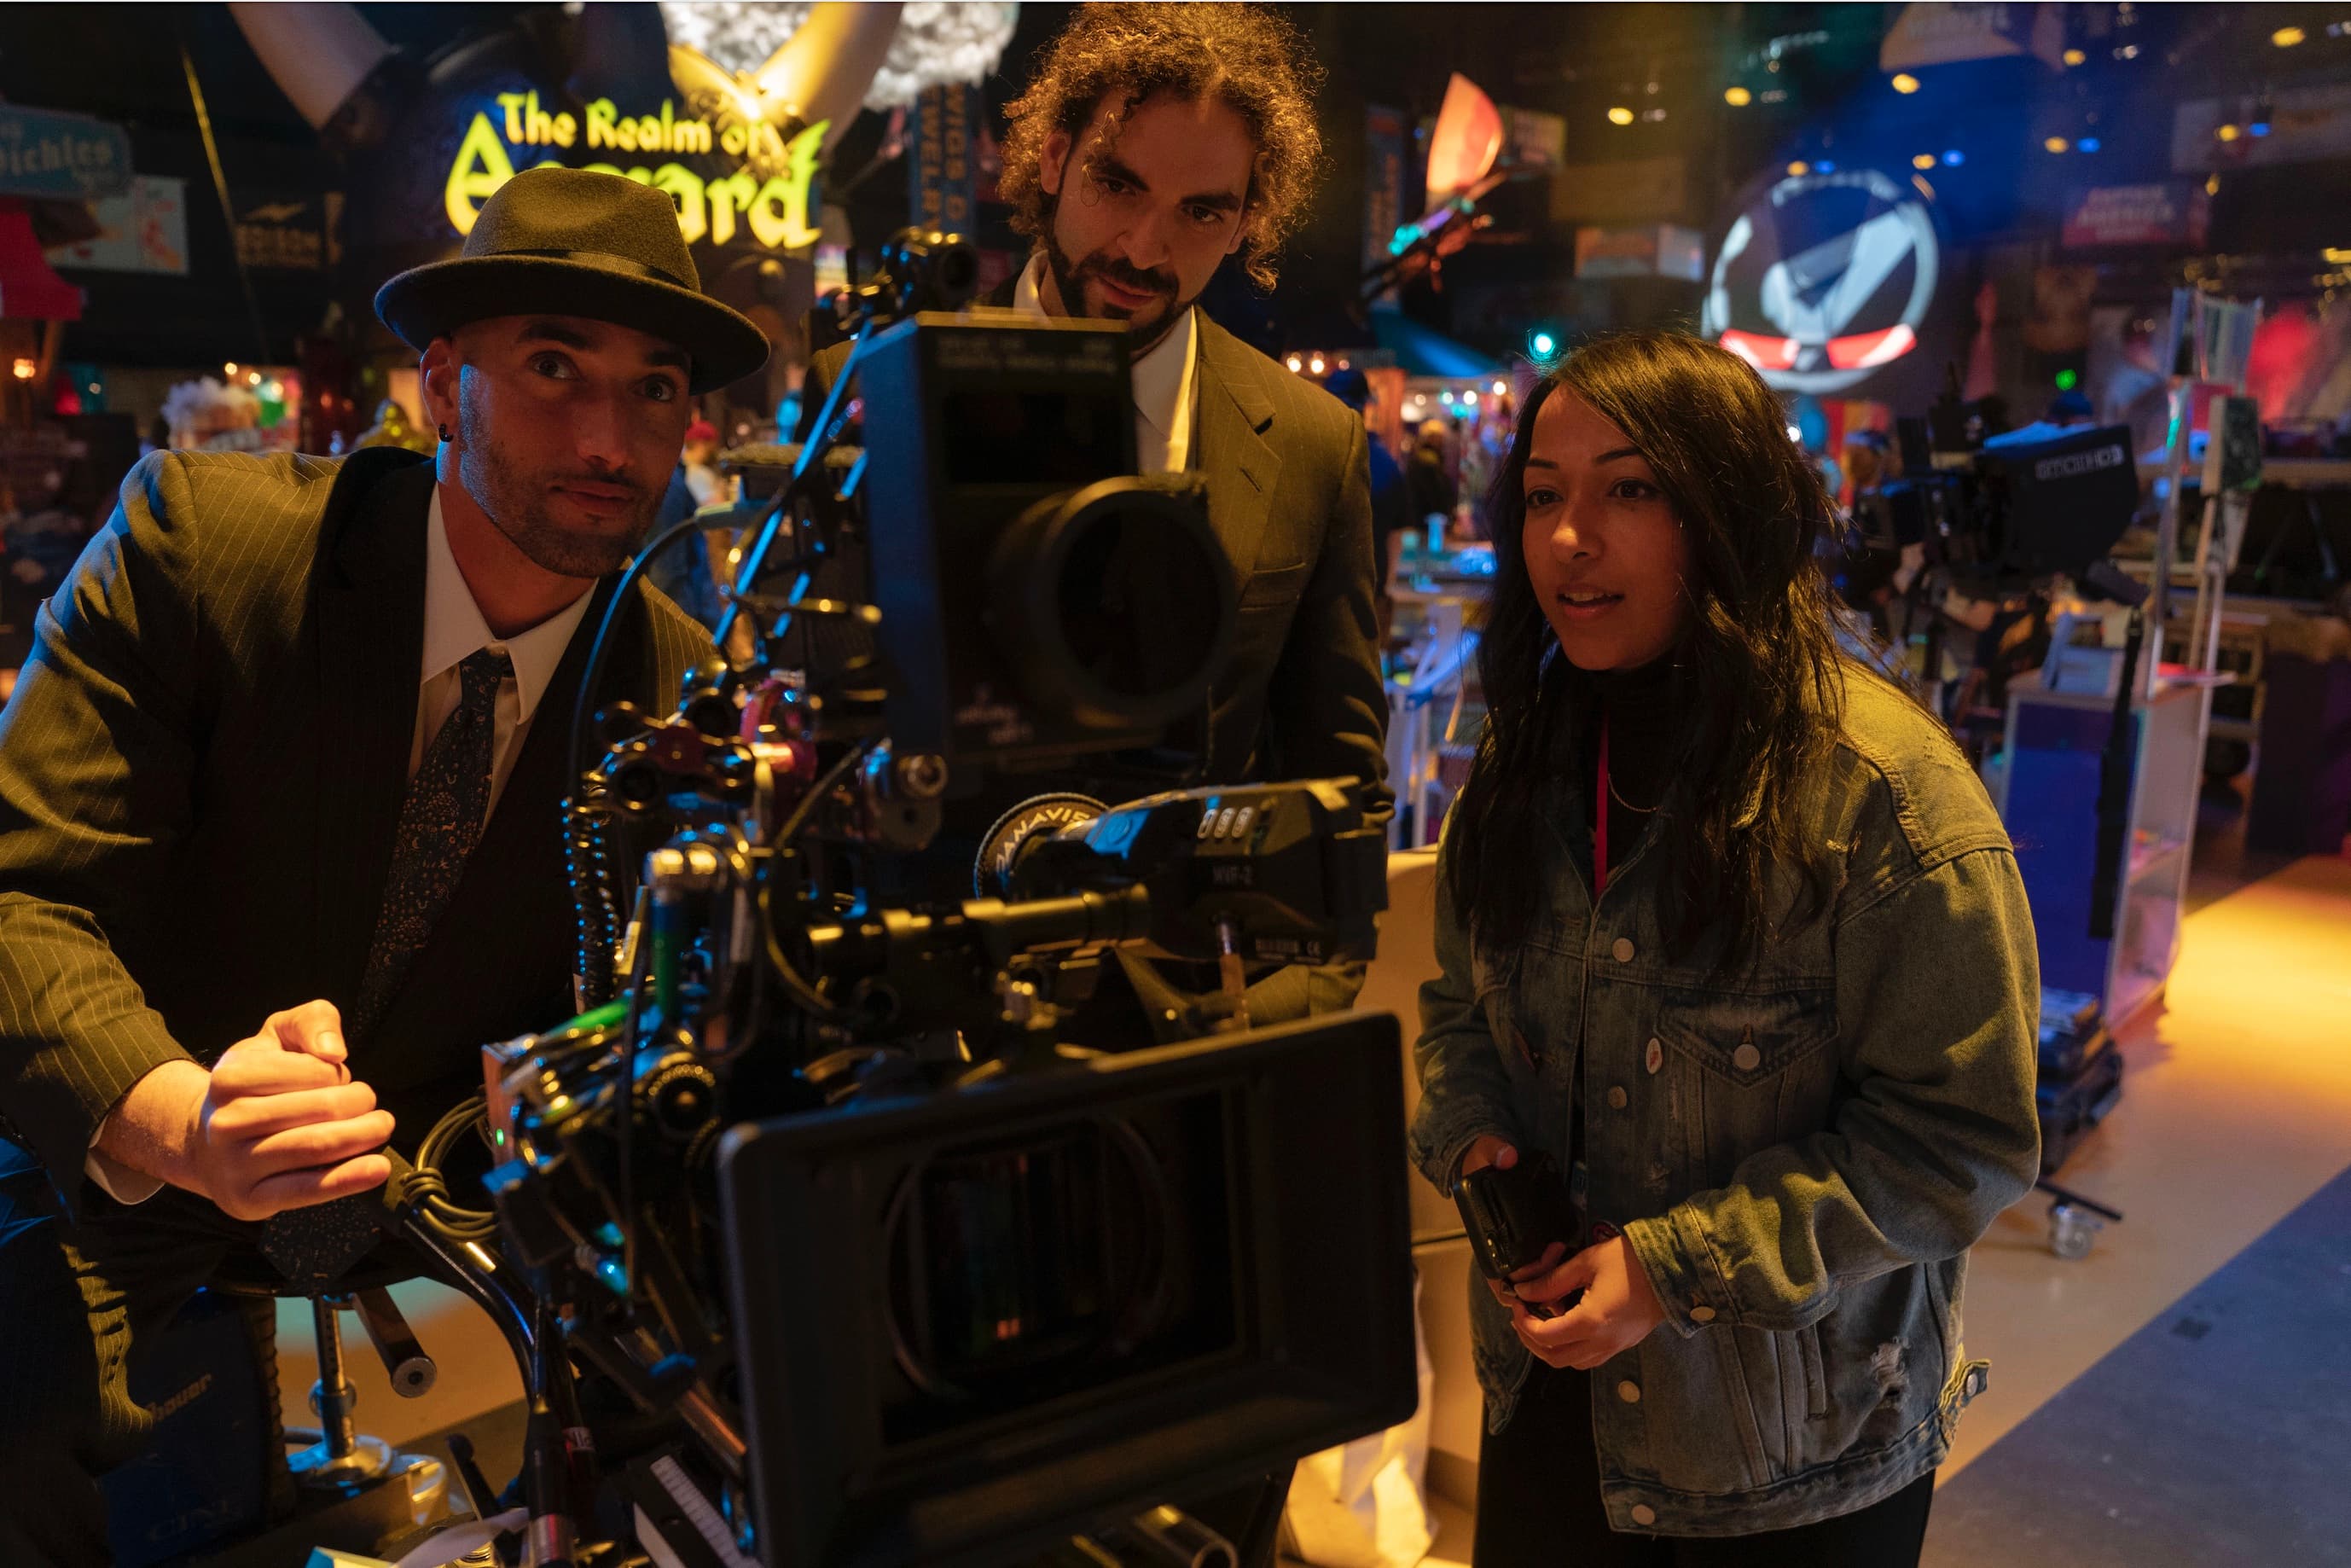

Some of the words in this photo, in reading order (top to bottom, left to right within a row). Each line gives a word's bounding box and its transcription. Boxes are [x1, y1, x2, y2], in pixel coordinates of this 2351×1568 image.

[496, 90, 577, 148] The
[586, 97, 711, 154] Realm
[445, 111, 833, 248] Aard
